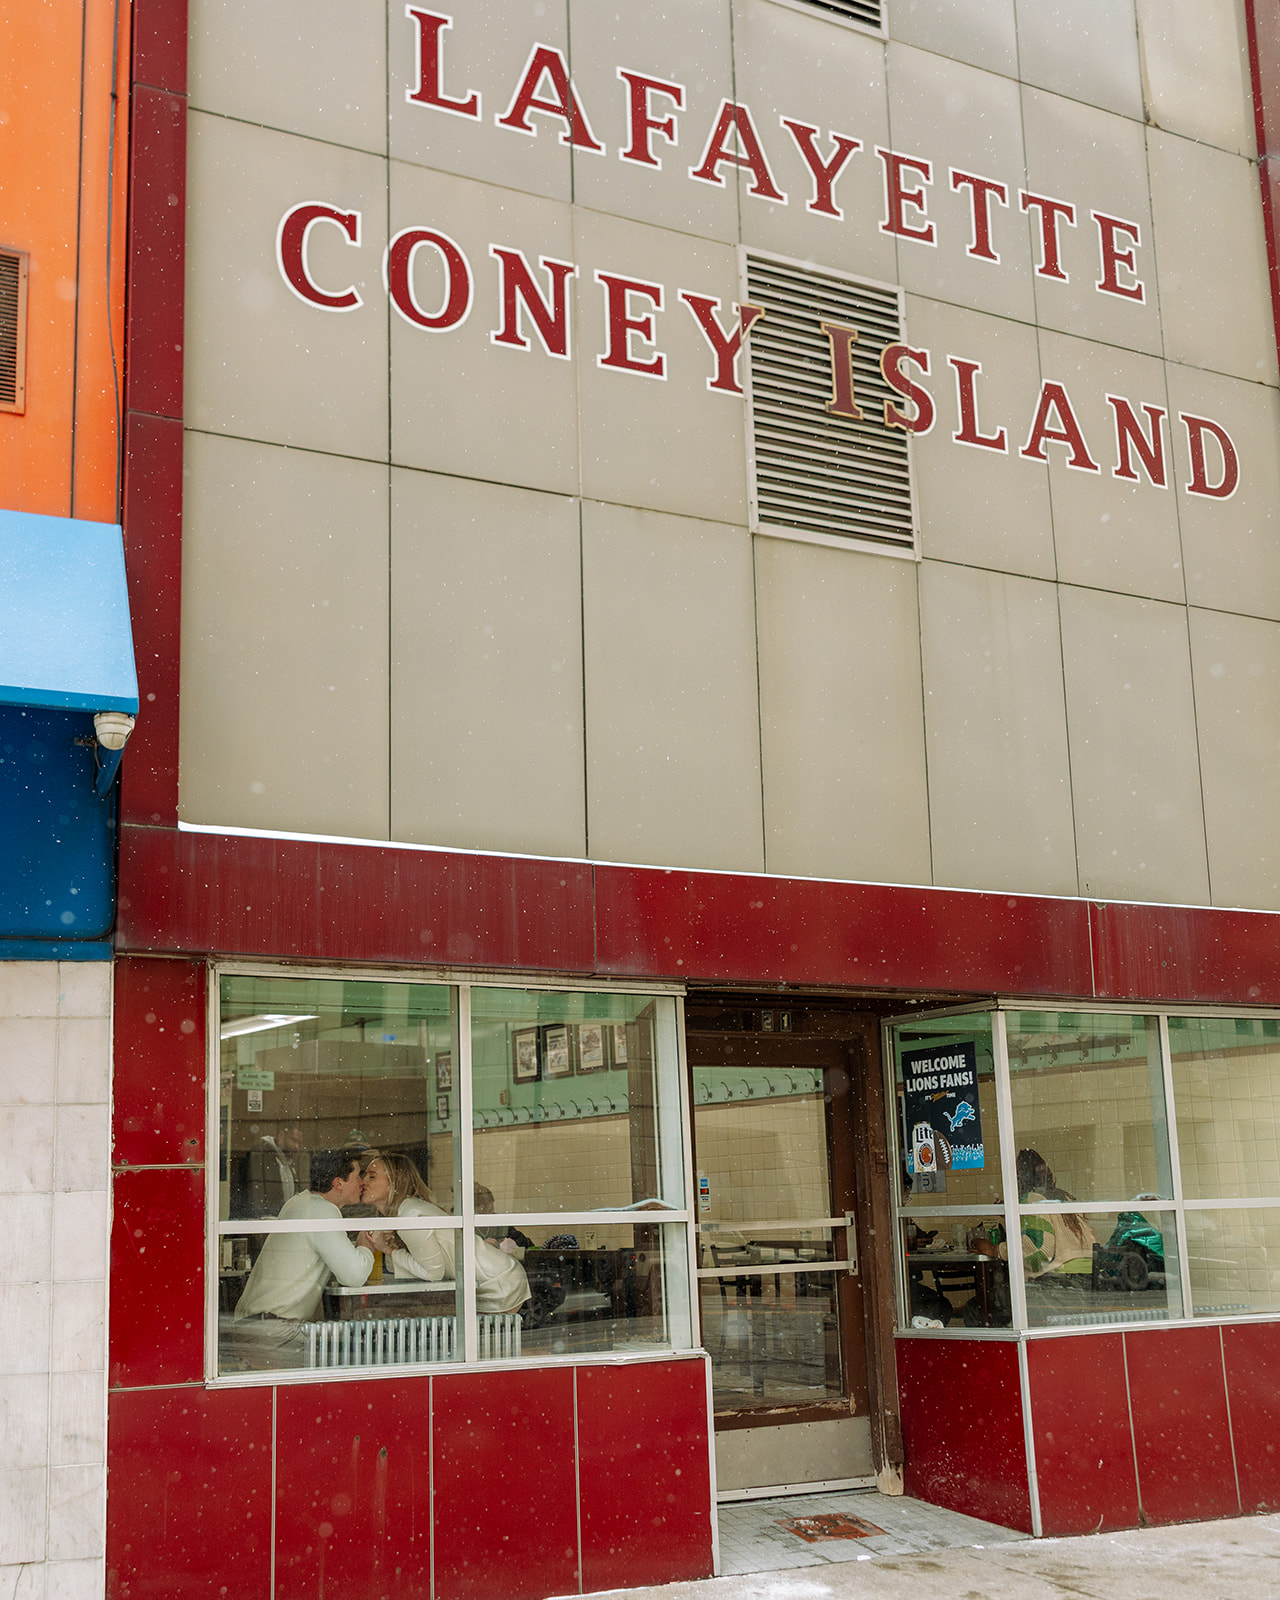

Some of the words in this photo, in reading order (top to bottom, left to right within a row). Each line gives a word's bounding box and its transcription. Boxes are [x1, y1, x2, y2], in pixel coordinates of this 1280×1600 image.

[405, 5, 1146, 306] LAFAYETTE
[276, 201, 762, 398] CONEY
[821, 323, 1240, 502] ISLAND
[906, 1076, 940, 1093] LIONS
[940, 1071, 974, 1090] FANS!
[911, 1054, 967, 1075] WELCOME
